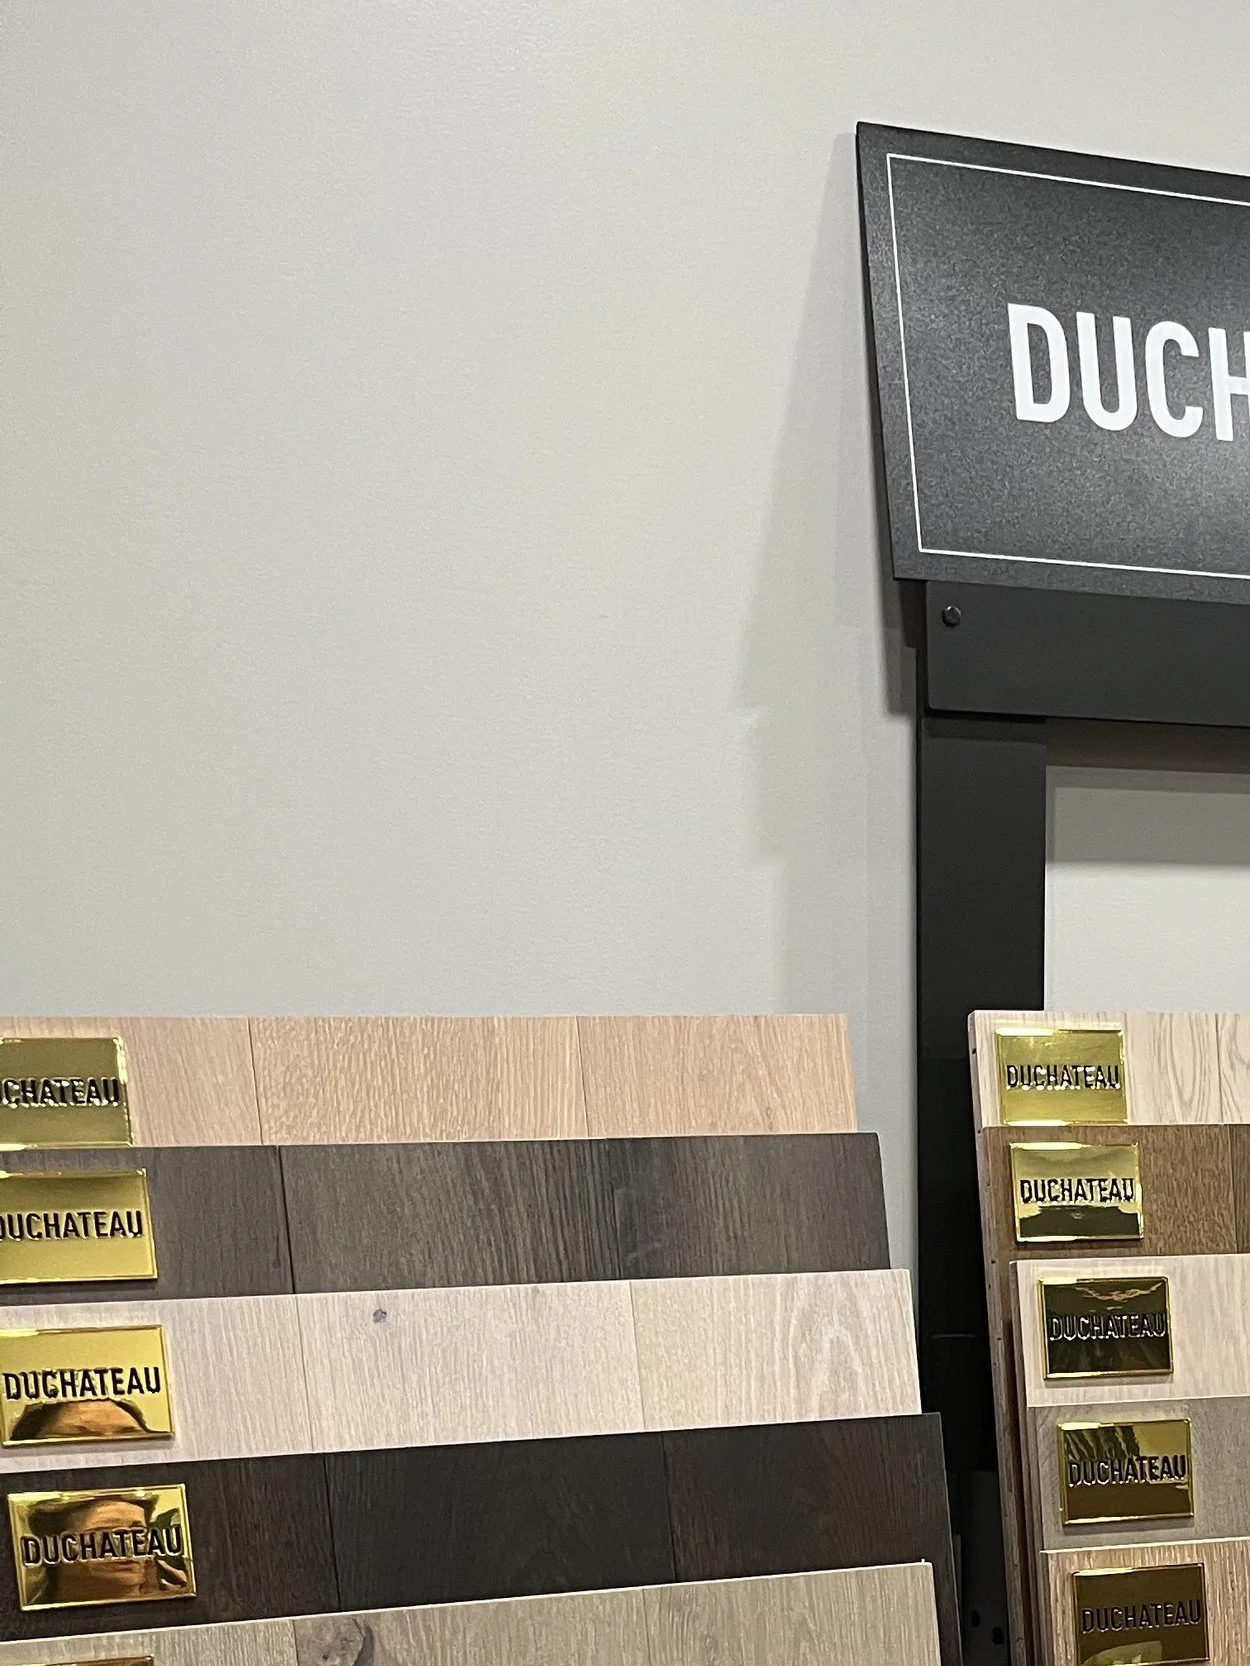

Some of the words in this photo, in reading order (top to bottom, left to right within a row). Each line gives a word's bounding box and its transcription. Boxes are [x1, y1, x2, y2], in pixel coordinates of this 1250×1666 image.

[1006, 1063, 1120, 1090] DUCHATEAU
[0, 1078, 120, 1106] CHATEAU
[1019, 1178, 1134, 1205] DUCHATEAU
[1049, 1313, 1166, 1341] DUCHATEAU
[2, 1367, 161, 1401] DUCHATEAU
[1069, 1455, 1186, 1487] DUCHATEAU
[21, 1527, 183, 1566] DUCHATEAU
[1081, 1599, 1202, 1634] DUCHATEAU
